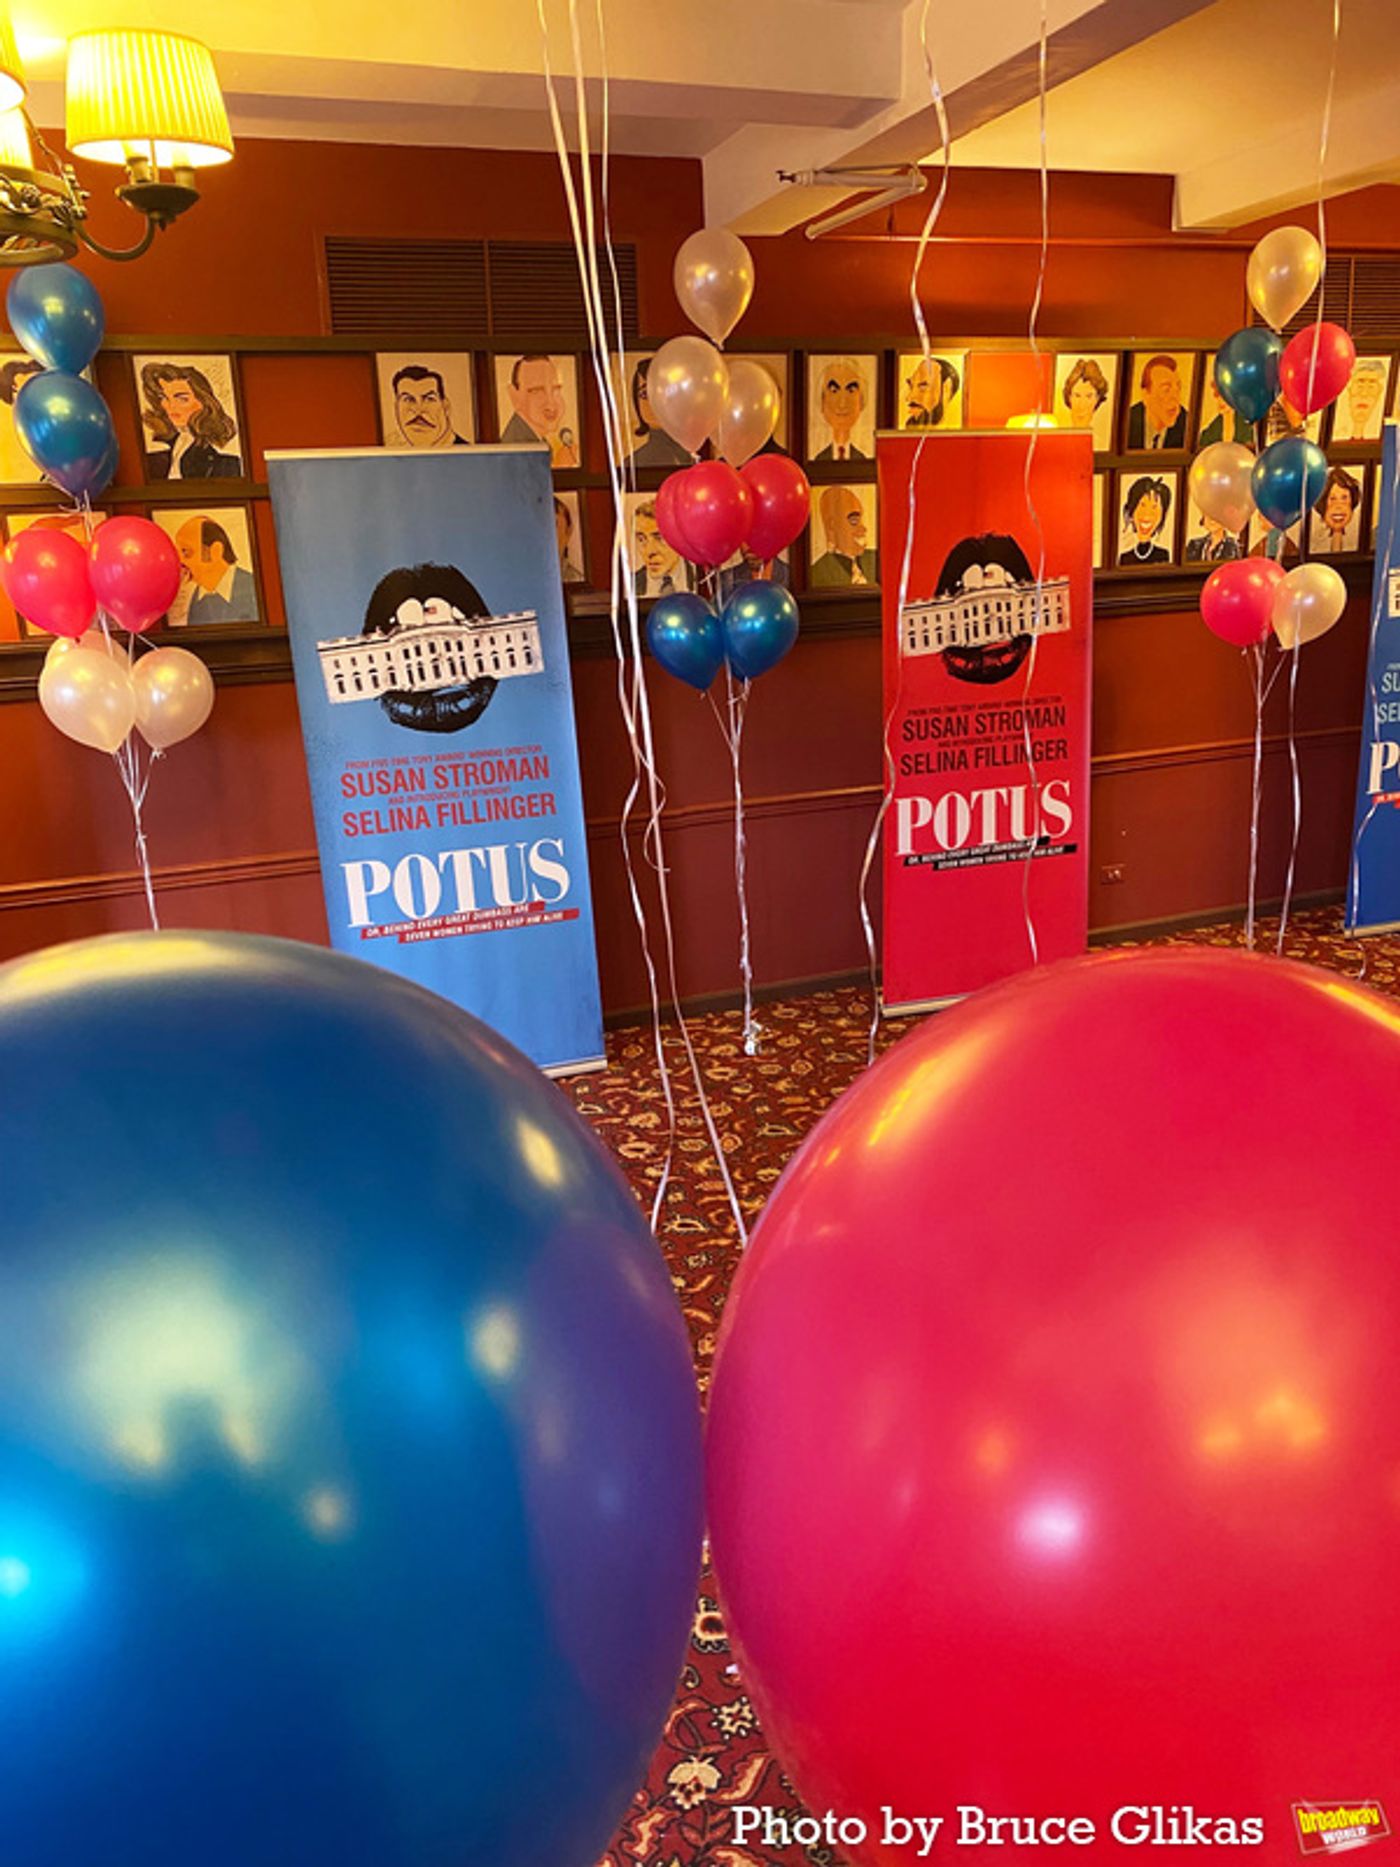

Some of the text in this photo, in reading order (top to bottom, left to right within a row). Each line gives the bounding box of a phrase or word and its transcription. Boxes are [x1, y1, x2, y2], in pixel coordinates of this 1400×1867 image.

[902, 716, 968, 742] SUSAN
[975, 706, 1066, 735] STROMAN
[341, 754, 549, 798] SUSAN STROMAN
[901, 749, 969, 777] SELINA
[974, 738, 1069, 769] FILLINGER
[343, 792, 557, 837] SELINA FILLINGER
[894, 780, 1073, 856] POTUS
[340, 838, 570, 927] POTUS
